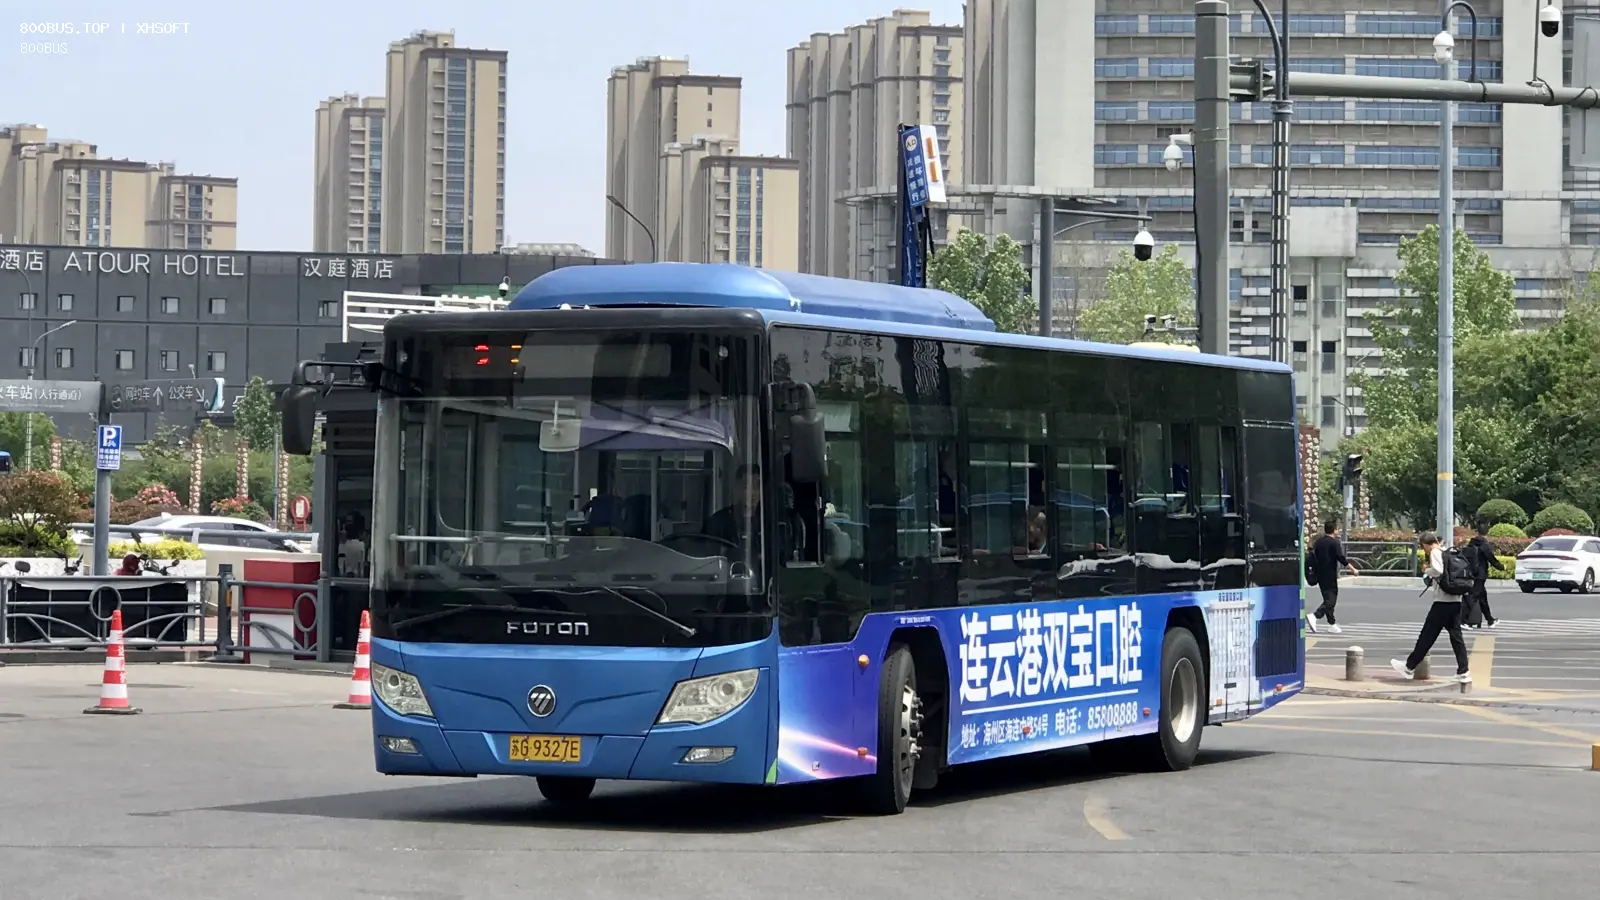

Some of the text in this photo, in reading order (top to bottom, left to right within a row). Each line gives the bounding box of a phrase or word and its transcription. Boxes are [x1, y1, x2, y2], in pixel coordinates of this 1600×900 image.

[0, 249, 43, 271] 酒店
[64, 251, 244, 276] ATOUR HOTEL
[303, 257, 393, 279] 汉庭酒店
[125, 386, 151, 401] 网约车
[168, 384, 194, 400] 公交车
[103, 427, 117, 447] P
[506, 621, 590, 636] FOTON
[959, 601, 1143, 705] 连云港双宝口腔
